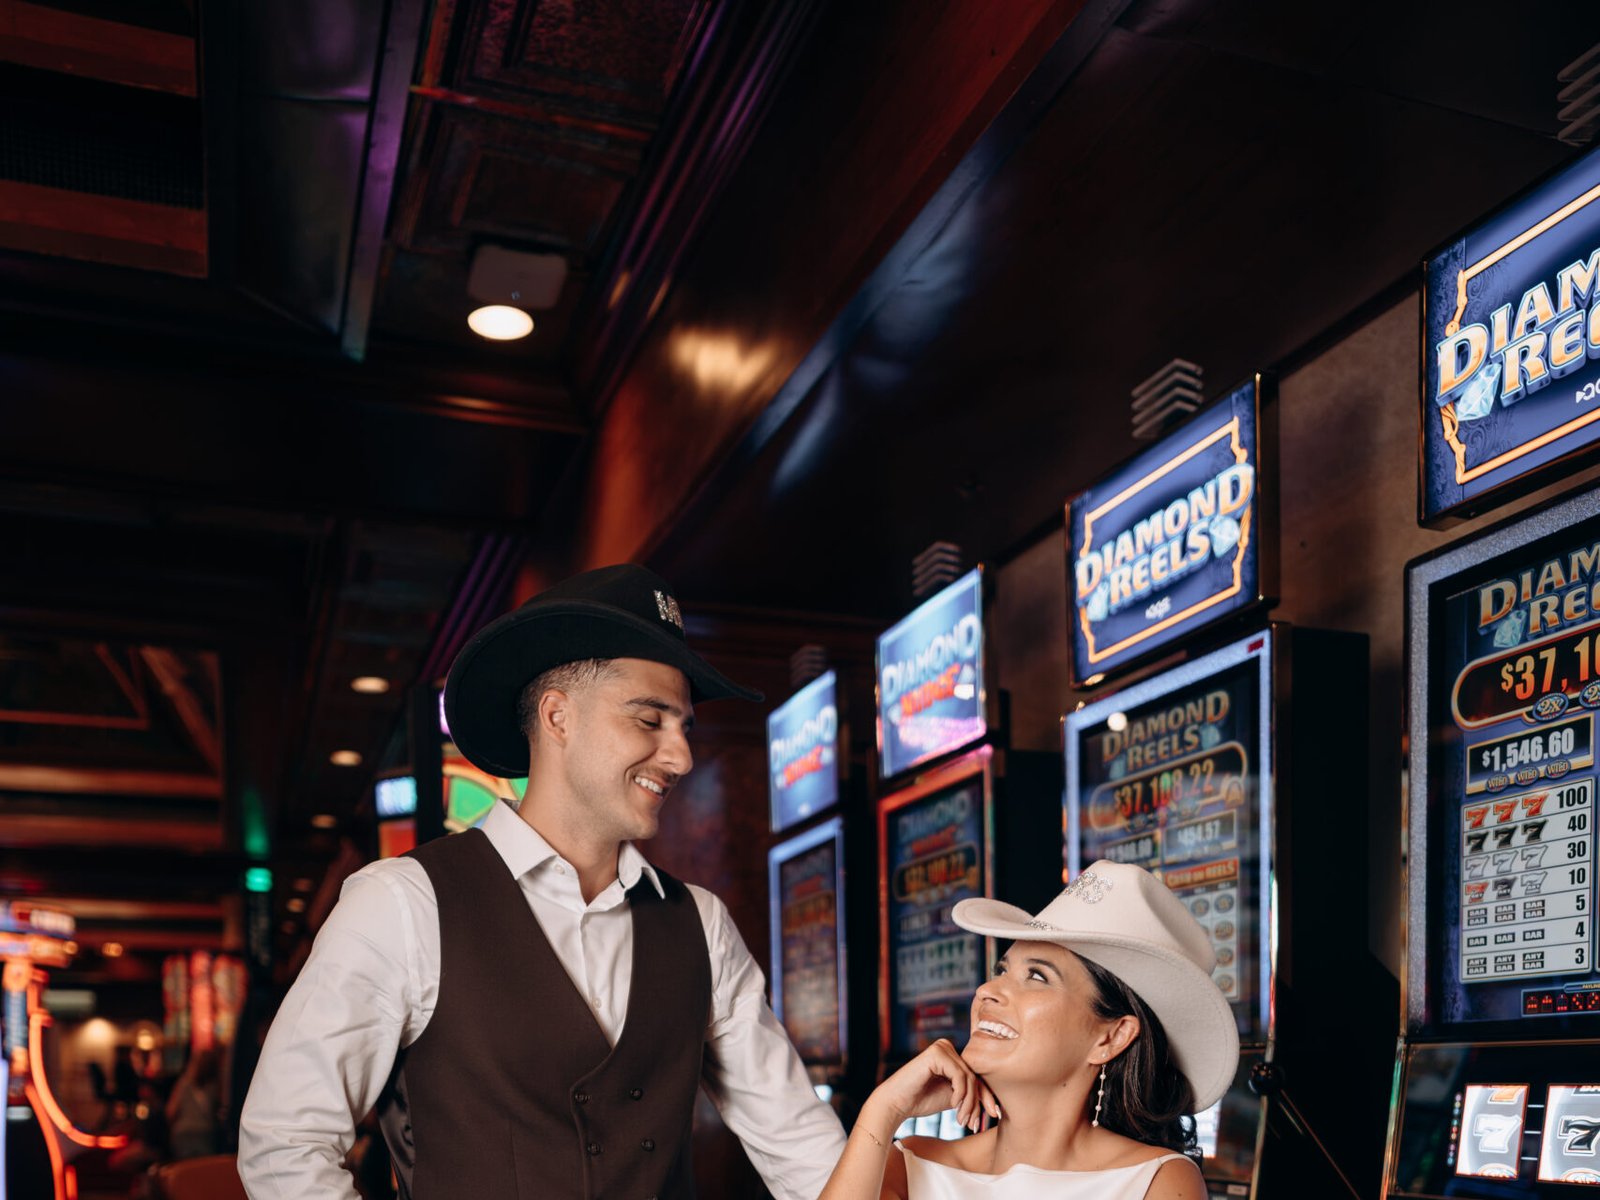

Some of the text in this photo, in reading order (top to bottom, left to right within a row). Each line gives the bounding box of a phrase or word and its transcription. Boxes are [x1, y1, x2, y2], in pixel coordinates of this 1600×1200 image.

[1076, 463, 1254, 599] DIAMOND
[1110, 520, 1210, 605] REELS
[1102, 691, 1229, 762] DIAMOND
[1127, 724, 1200, 771] REELS
[1482, 728, 1574, 772] $1,546.60
[1466, 786, 1587, 829] 7 7 7 100
[1466, 814, 1587, 854] 7 7 7 40
[1567, 841, 1586, 859] 30
[1569, 867, 1585, 885] 10
[1525, 901, 1543, 909] BAR
[1576, 895, 1585, 911] 5
[1469, 921, 1585, 946] BAR BAR BAR 4
[1469, 948, 1584, 966] ANY ANY ANY 3
[1496, 964, 1513, 972] BAR
[1525, 961, 1542, 969] BAR
[1474, 1114, 1522, 1153] 7
[1557, 1115, 1600, 1156] 7
